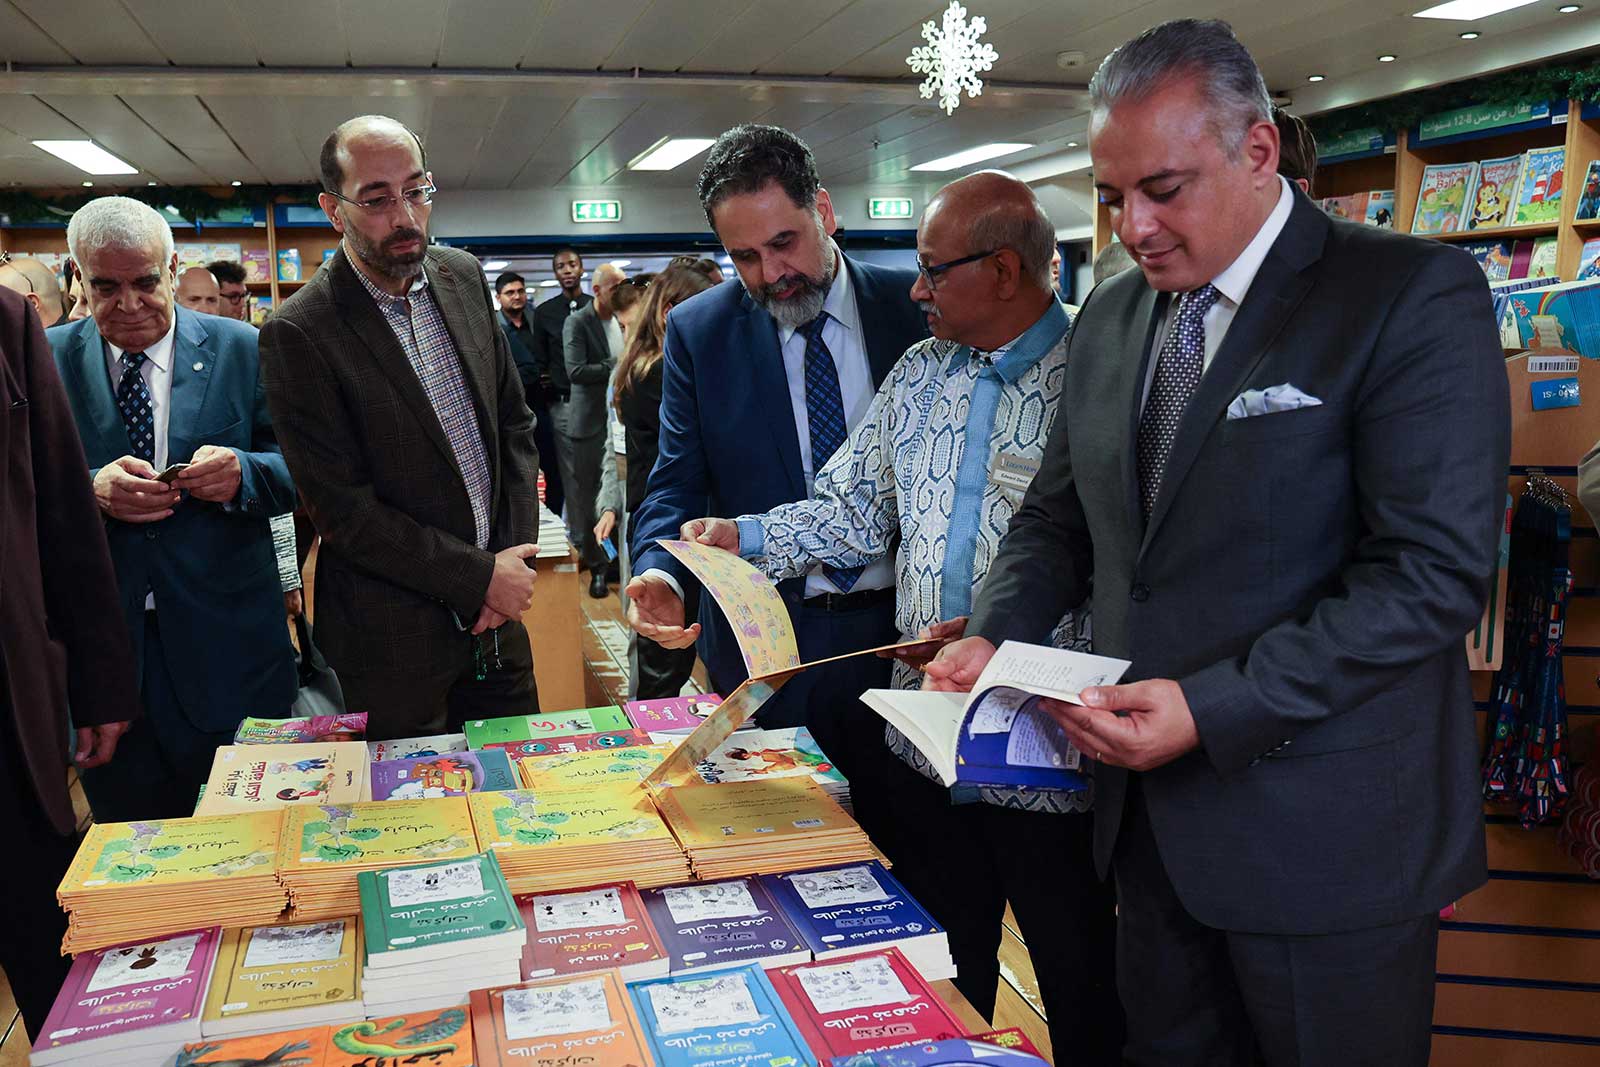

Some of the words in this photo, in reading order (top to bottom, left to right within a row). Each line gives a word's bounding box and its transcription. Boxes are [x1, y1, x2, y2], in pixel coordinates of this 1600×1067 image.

[390, 907, 435, 919] طالب
[812, 908, 852, 920] طالب
[677, 924, 718, 936] طالب
[538, 933, 580, 944] طالب
[239, 969, 285, 981] طالب
[78, 991, 126, 1007] طالب
[823, 1014, 869, 1029] طالب
[664, 1033, 712, 1048] طالب
[507, 1043, 557, 1057] طالب
